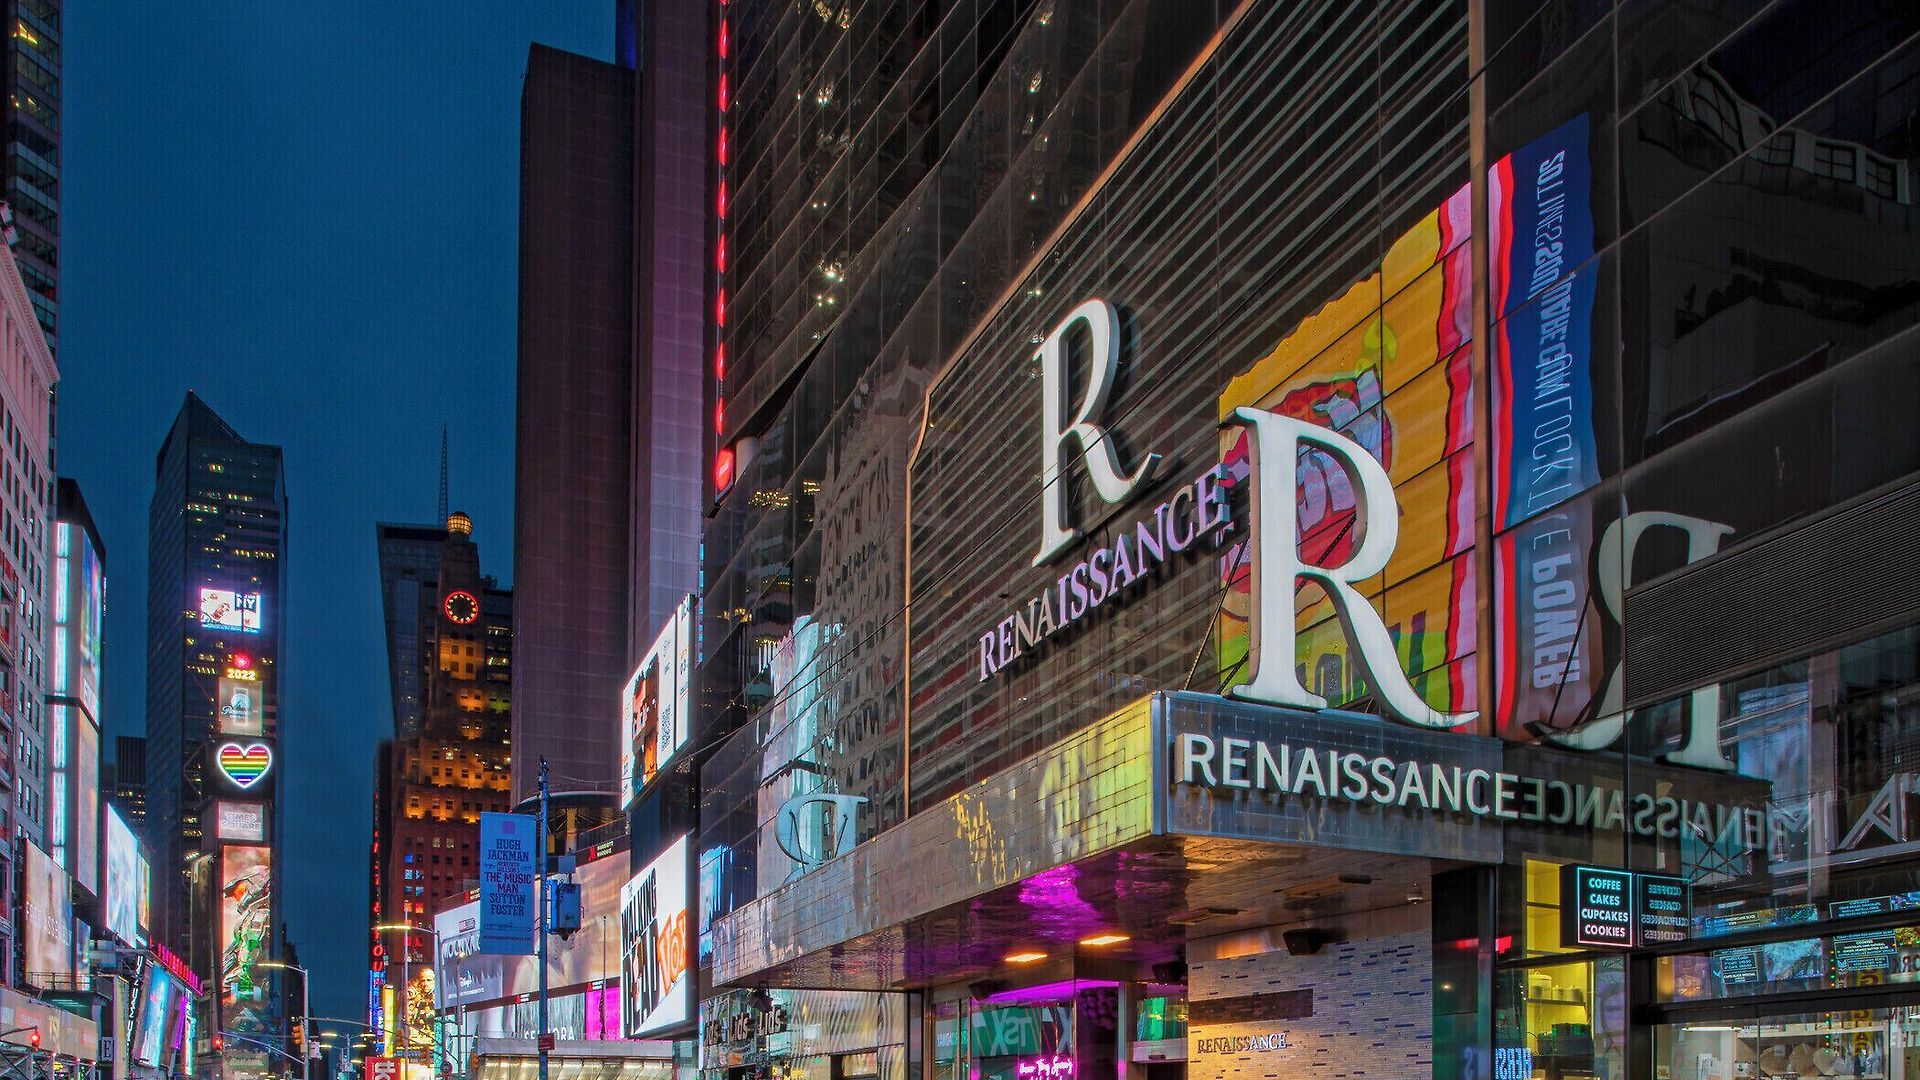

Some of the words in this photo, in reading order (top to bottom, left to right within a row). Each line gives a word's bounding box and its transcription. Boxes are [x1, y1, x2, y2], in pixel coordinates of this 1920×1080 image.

[1031, 299, 1162, 568] R
[978, 463, 1231, 684] RENAISSANCE
[1231, 406, 1480, 728] R
[227, 668, 256, 681] 2022
[1177, 732, 1520, 819] RENAISSANCE
[224, 811, 257, 822] TIMES
[222, 820, 262, 830] SQUARE
[496, 838, 522, 851] HUGH
[487, 849, 530, 862] JACKMAN
[485, 872, 503, 883] THE
[504, 873, 533, 885] MUSIC
[1588, 877, 1622, 891] COFFEE
[497, 883, 520, 895] MAN
[489, 894, 526, 906] SUTTON
[1589, 893, 1621, 907] CAKES
[490, 904, 526, 917] FOSTER
[621, 867, 658, 956] WALKING
[1581, 908, 1629, 923] CUPCAKES
[1584, 924, 1626, 938] COOKIES
[758, 1005, 782, 1036] Lids
[524, 1025, 575, 1041] SEORA
[1197, 1032, 1288, 1054] RENAISSANCE
